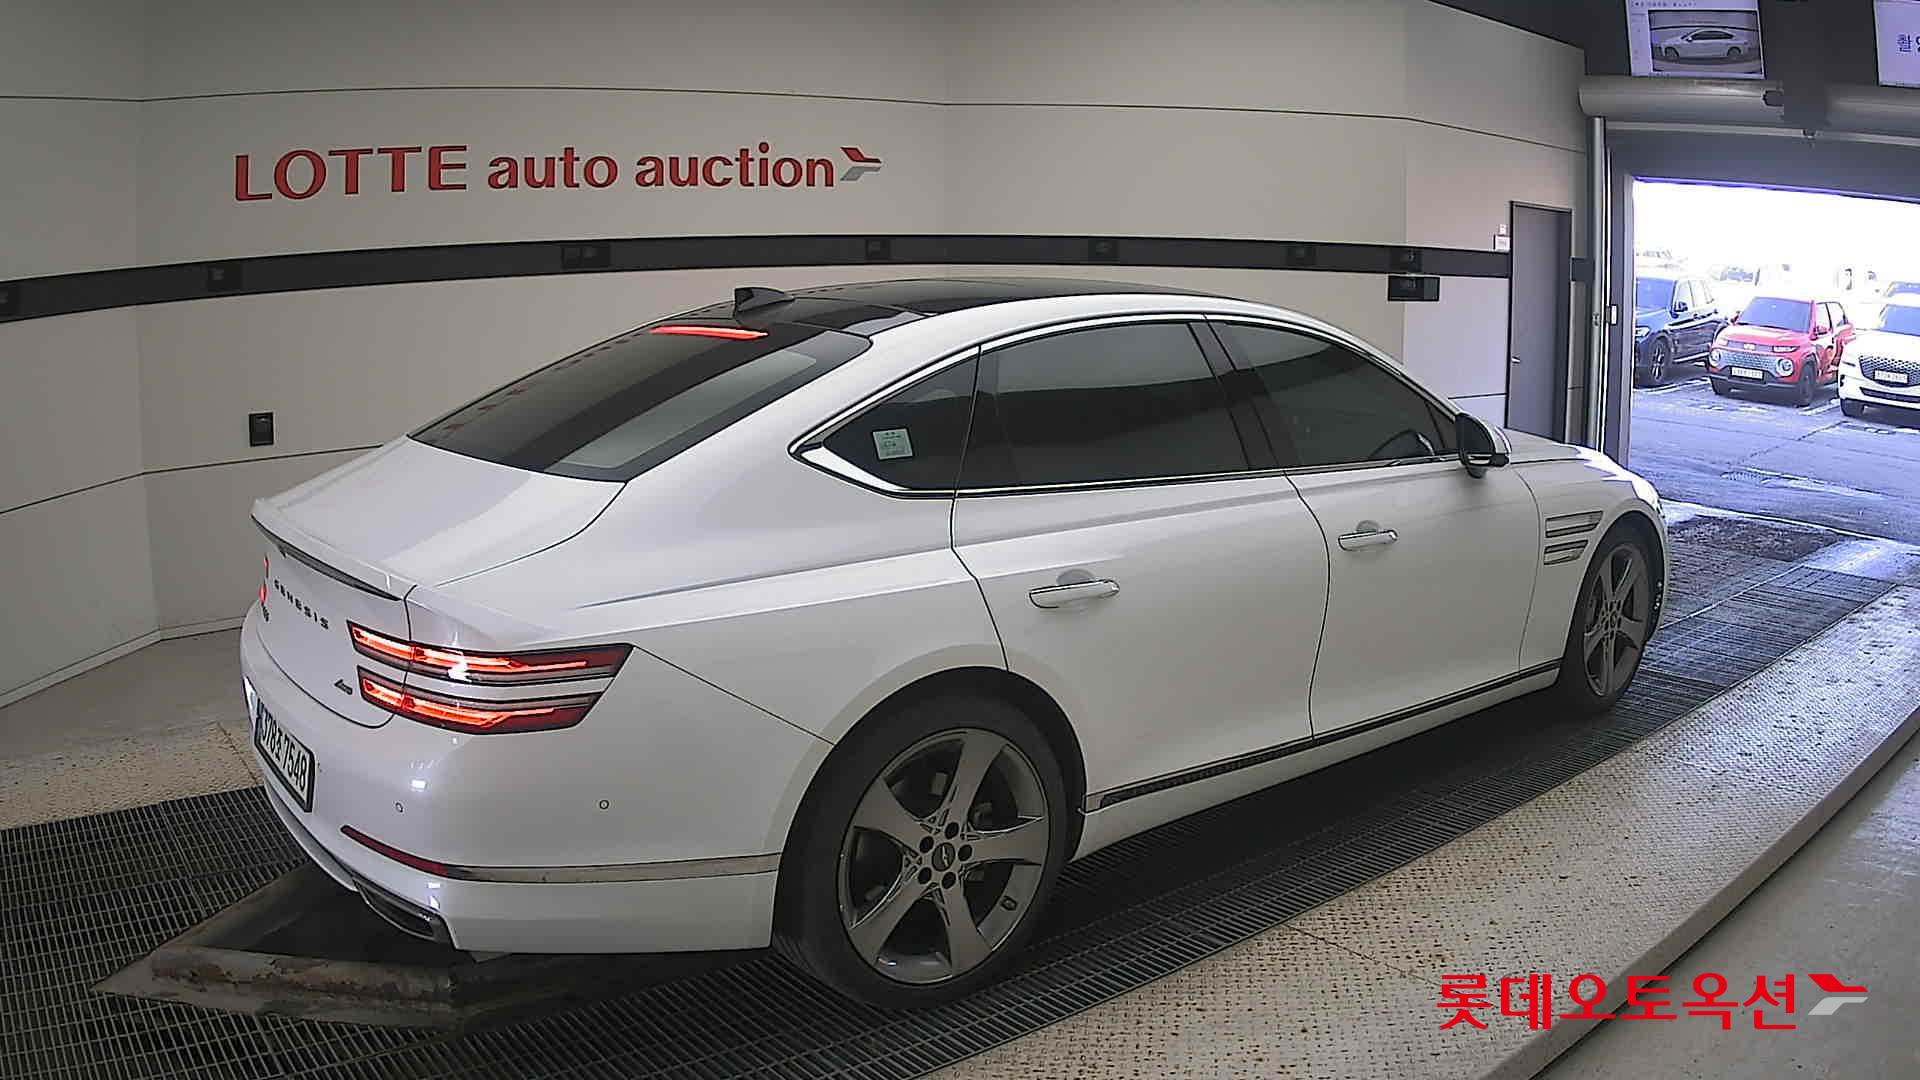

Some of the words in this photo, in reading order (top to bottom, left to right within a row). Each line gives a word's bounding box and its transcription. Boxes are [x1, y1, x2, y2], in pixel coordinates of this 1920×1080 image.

[235, 145, 468, 201] LOTTE
[488, 147, 619, 190] auto
[634, 142, 836, 188] auction
[274, 579, 329, 630] GENESIS
[282, 733, 308, 793] 7548
